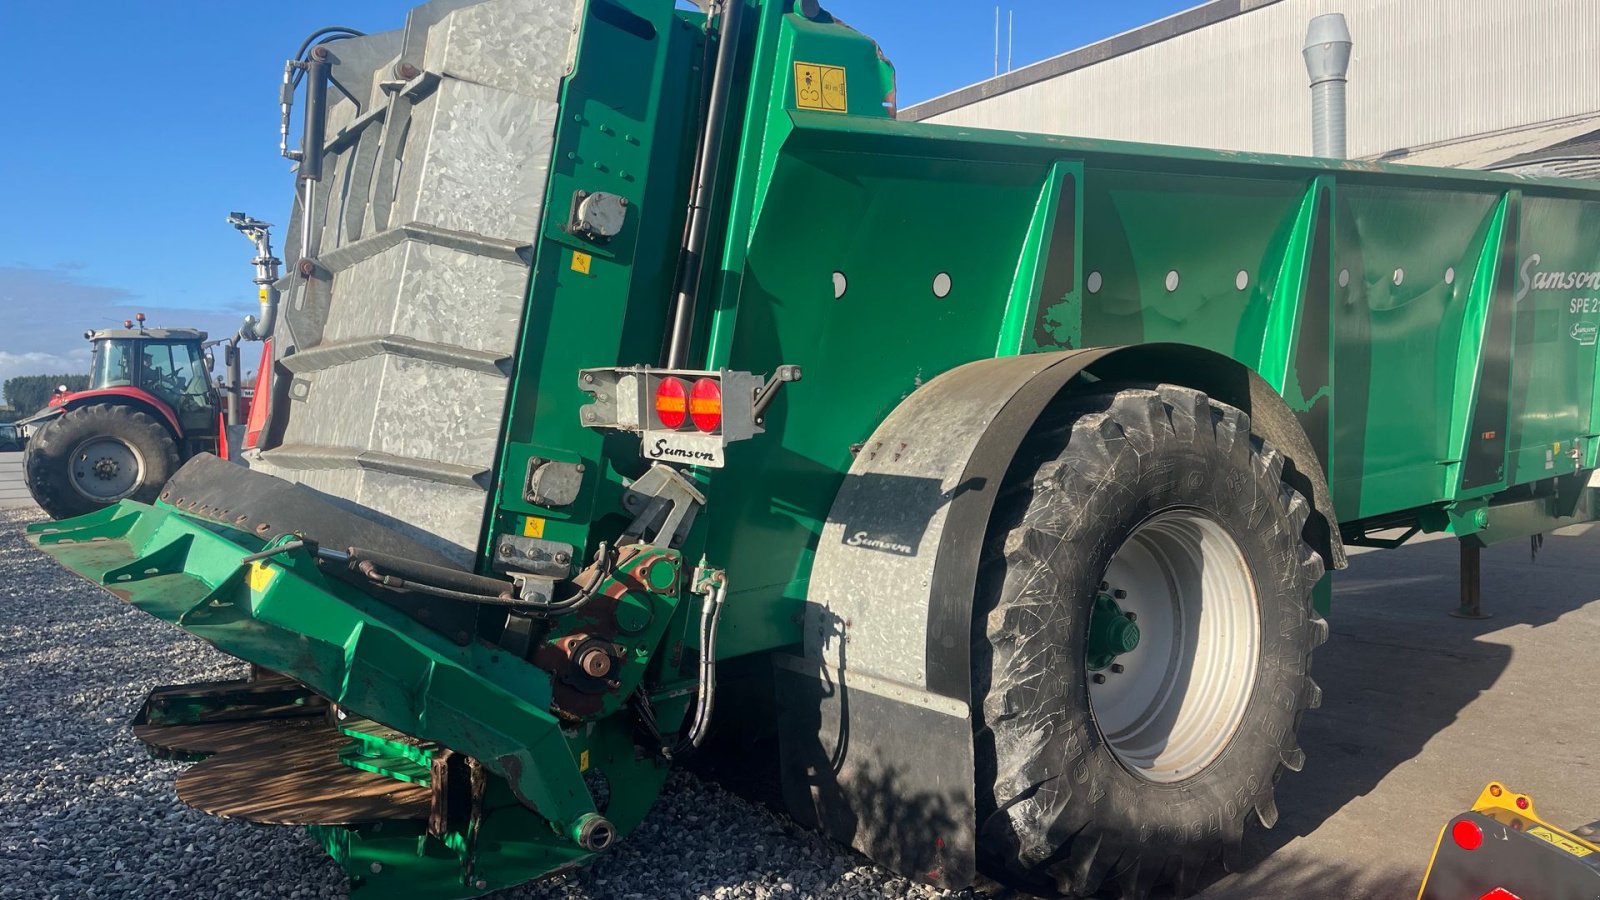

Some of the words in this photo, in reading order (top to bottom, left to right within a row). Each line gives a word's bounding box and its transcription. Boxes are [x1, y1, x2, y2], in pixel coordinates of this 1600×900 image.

[1515, 253, 1600, 302] Samson
[1570, 298, 1590, 313] SPE
[650, 438, 715, 461] Samson
[846, 531, 911, 553] Samson
